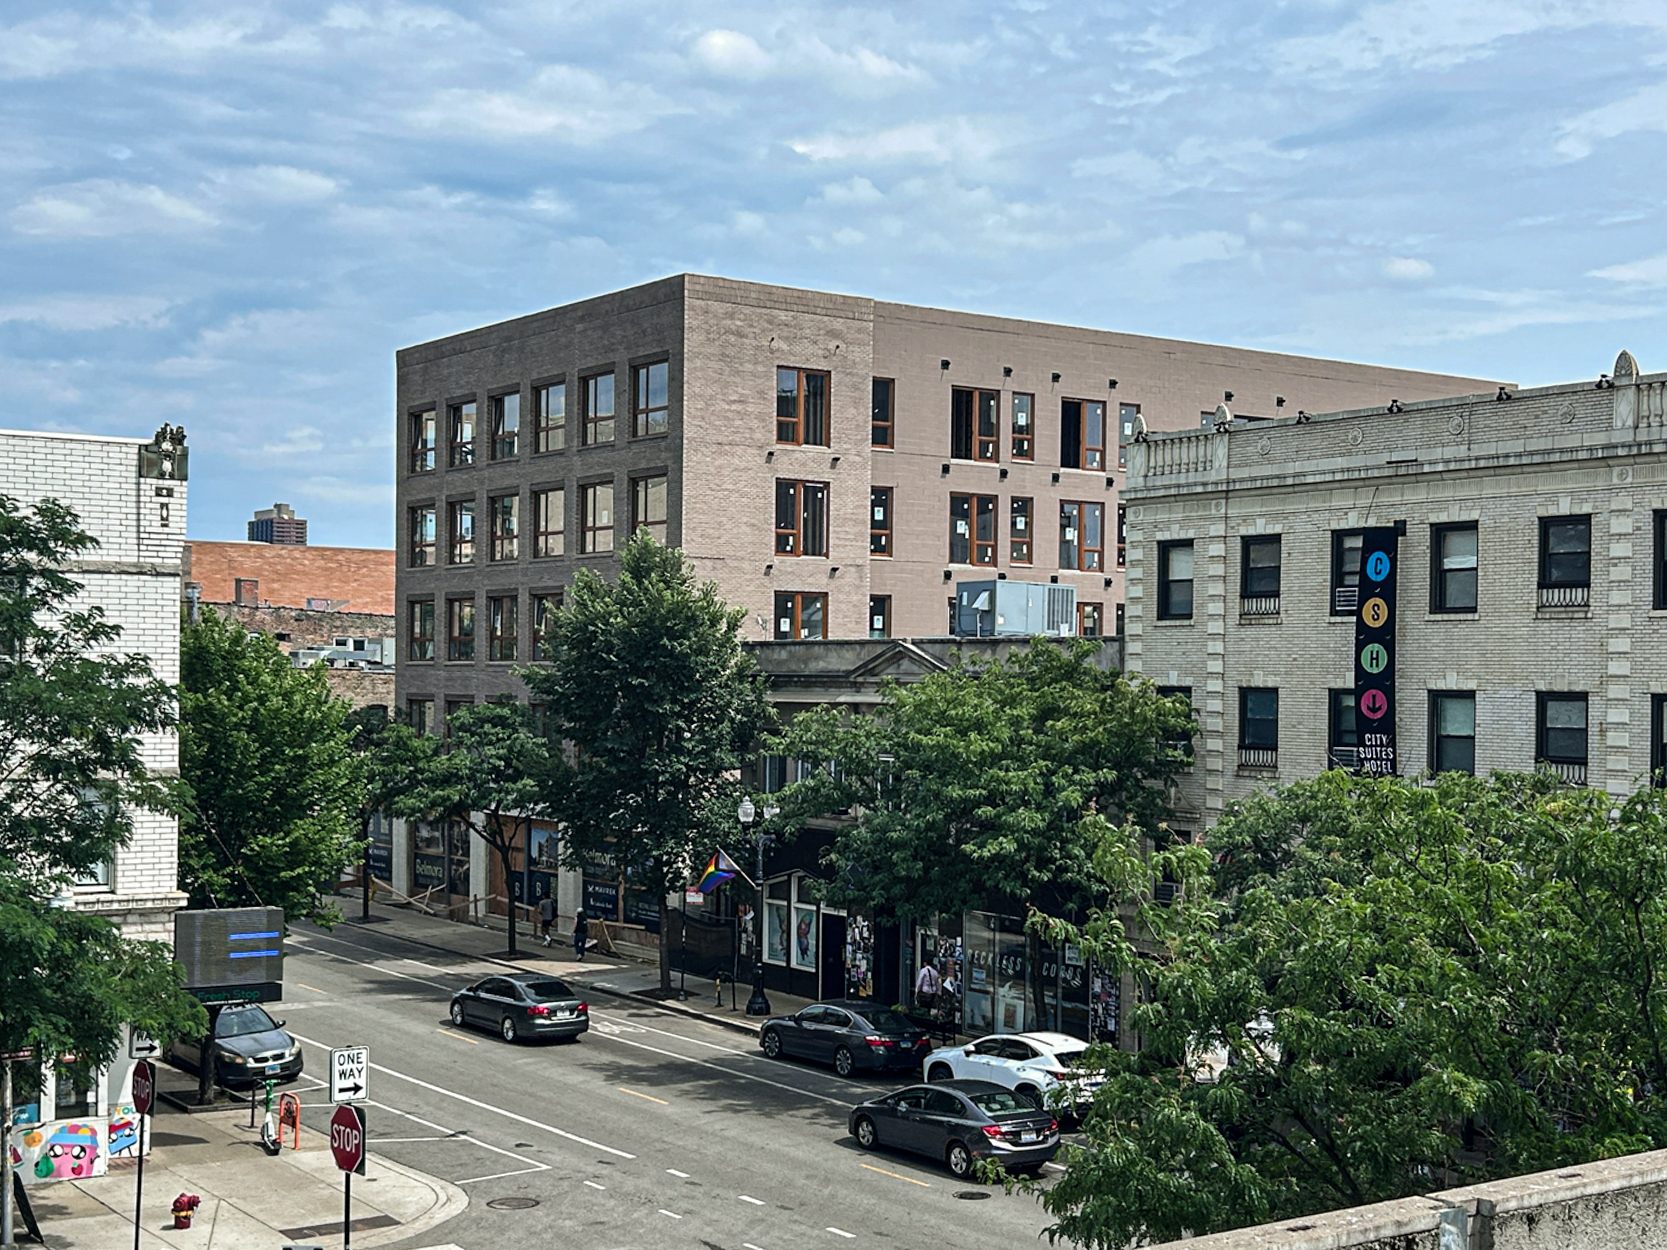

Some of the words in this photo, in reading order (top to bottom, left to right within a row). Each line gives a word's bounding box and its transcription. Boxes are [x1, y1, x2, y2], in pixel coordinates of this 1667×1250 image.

[1374, 557, 1383, 575] C
[1372, 603, 1380, 621] S
[1370, 650, 1379, 668] H
[1364, 733, 1388, 746] CITY
[1358, 746, 1394, 759] SUITES
[1364, 760, 1393, 773] HOTEL
[415, 858, 444, 878] Belmora
[967, 949, 1022, 971] RECKLESS
[1028, 961, 1082, 980] CORDS
[197, 990, 230, 1001] Fresh
[233, 989, 261, 1001] Stop
[337, 1052, 364, 1066] ONE
[338, 1066, 365, 1081] WAY
[133, 1076, 151, 1100] STOP
[332, 1123, 360, 1153] STOP
